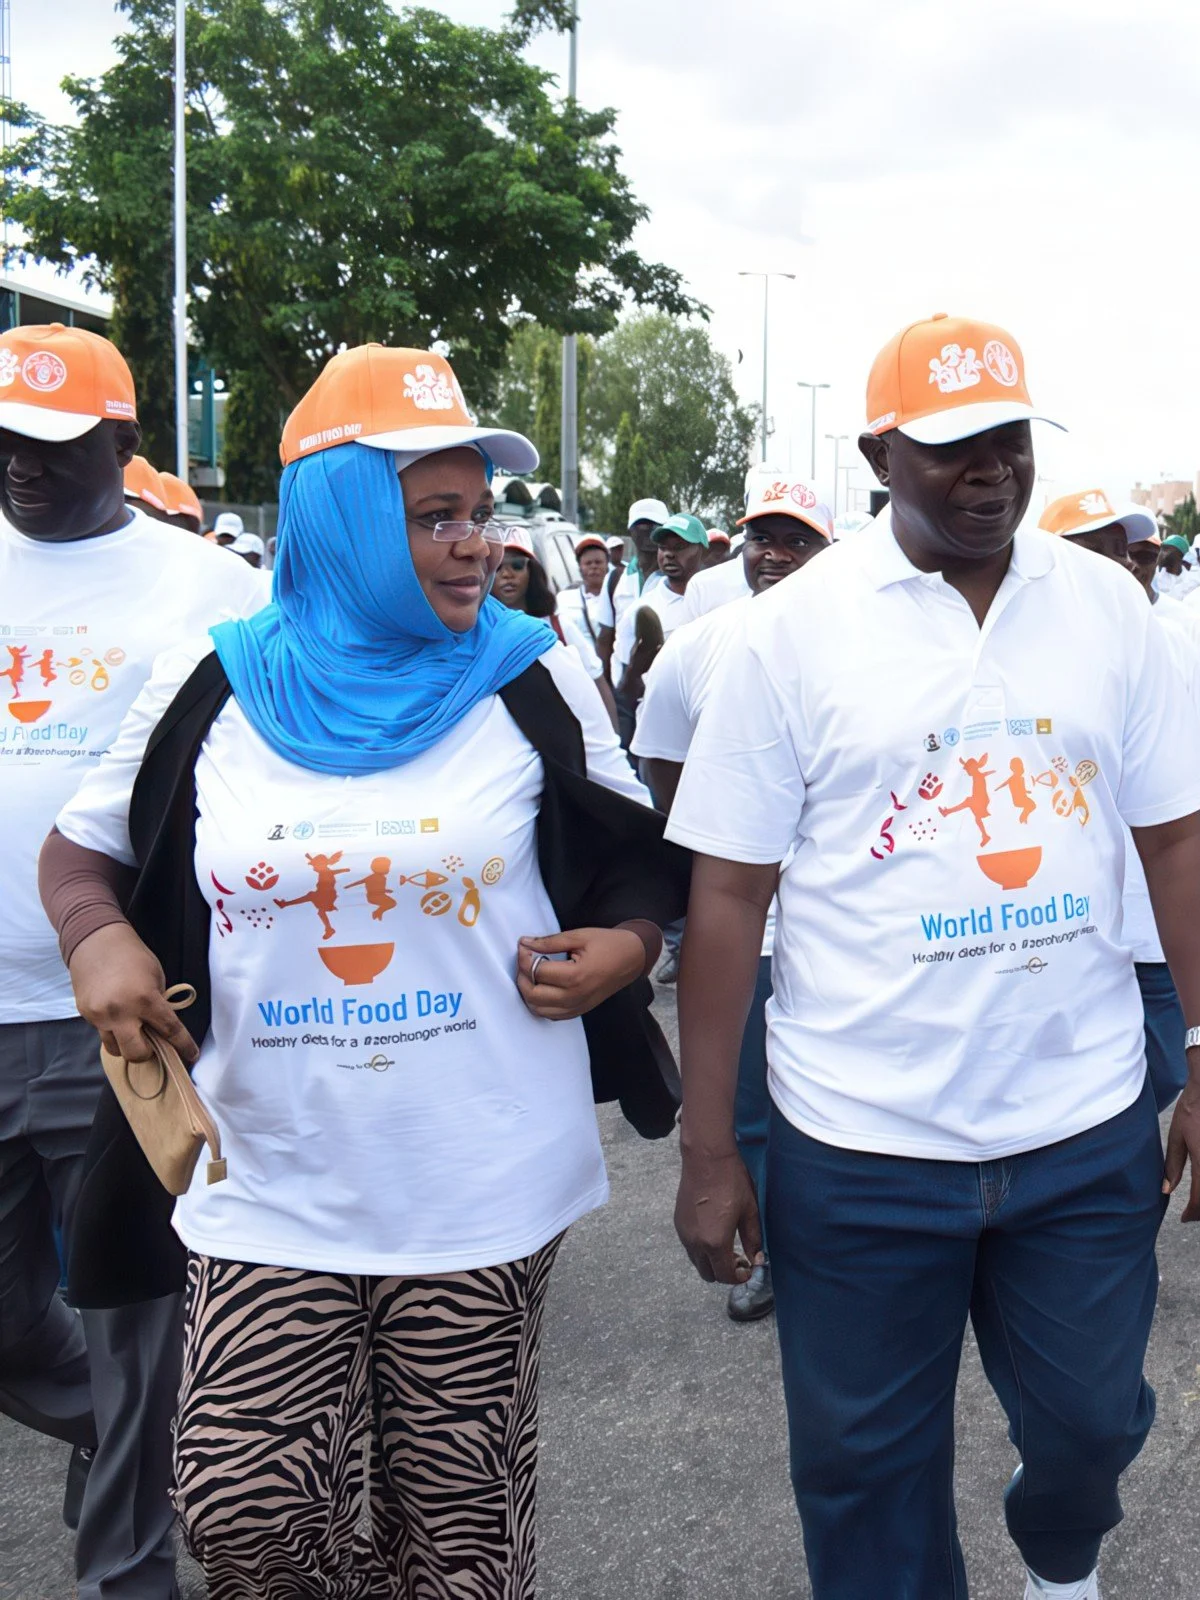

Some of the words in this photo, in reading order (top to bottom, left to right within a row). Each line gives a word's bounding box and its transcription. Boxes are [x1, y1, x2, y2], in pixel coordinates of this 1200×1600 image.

[57, 723, 89, 745] Day
[920, 906, 993, 941] World
[1002, 896, 1058, 930] Food
[1063, 893, 1091, 922] Day
[988, 942, 1006, 954] for
[258, 997, 335, 1028] World
[342, 993, 408, 1026] Food
[416, 990, 463, 1018] Day
[331, 1035, 347, 1048] for
[350, 1038, 359, 1048] a
[444, 1019, 477, 1034] world
